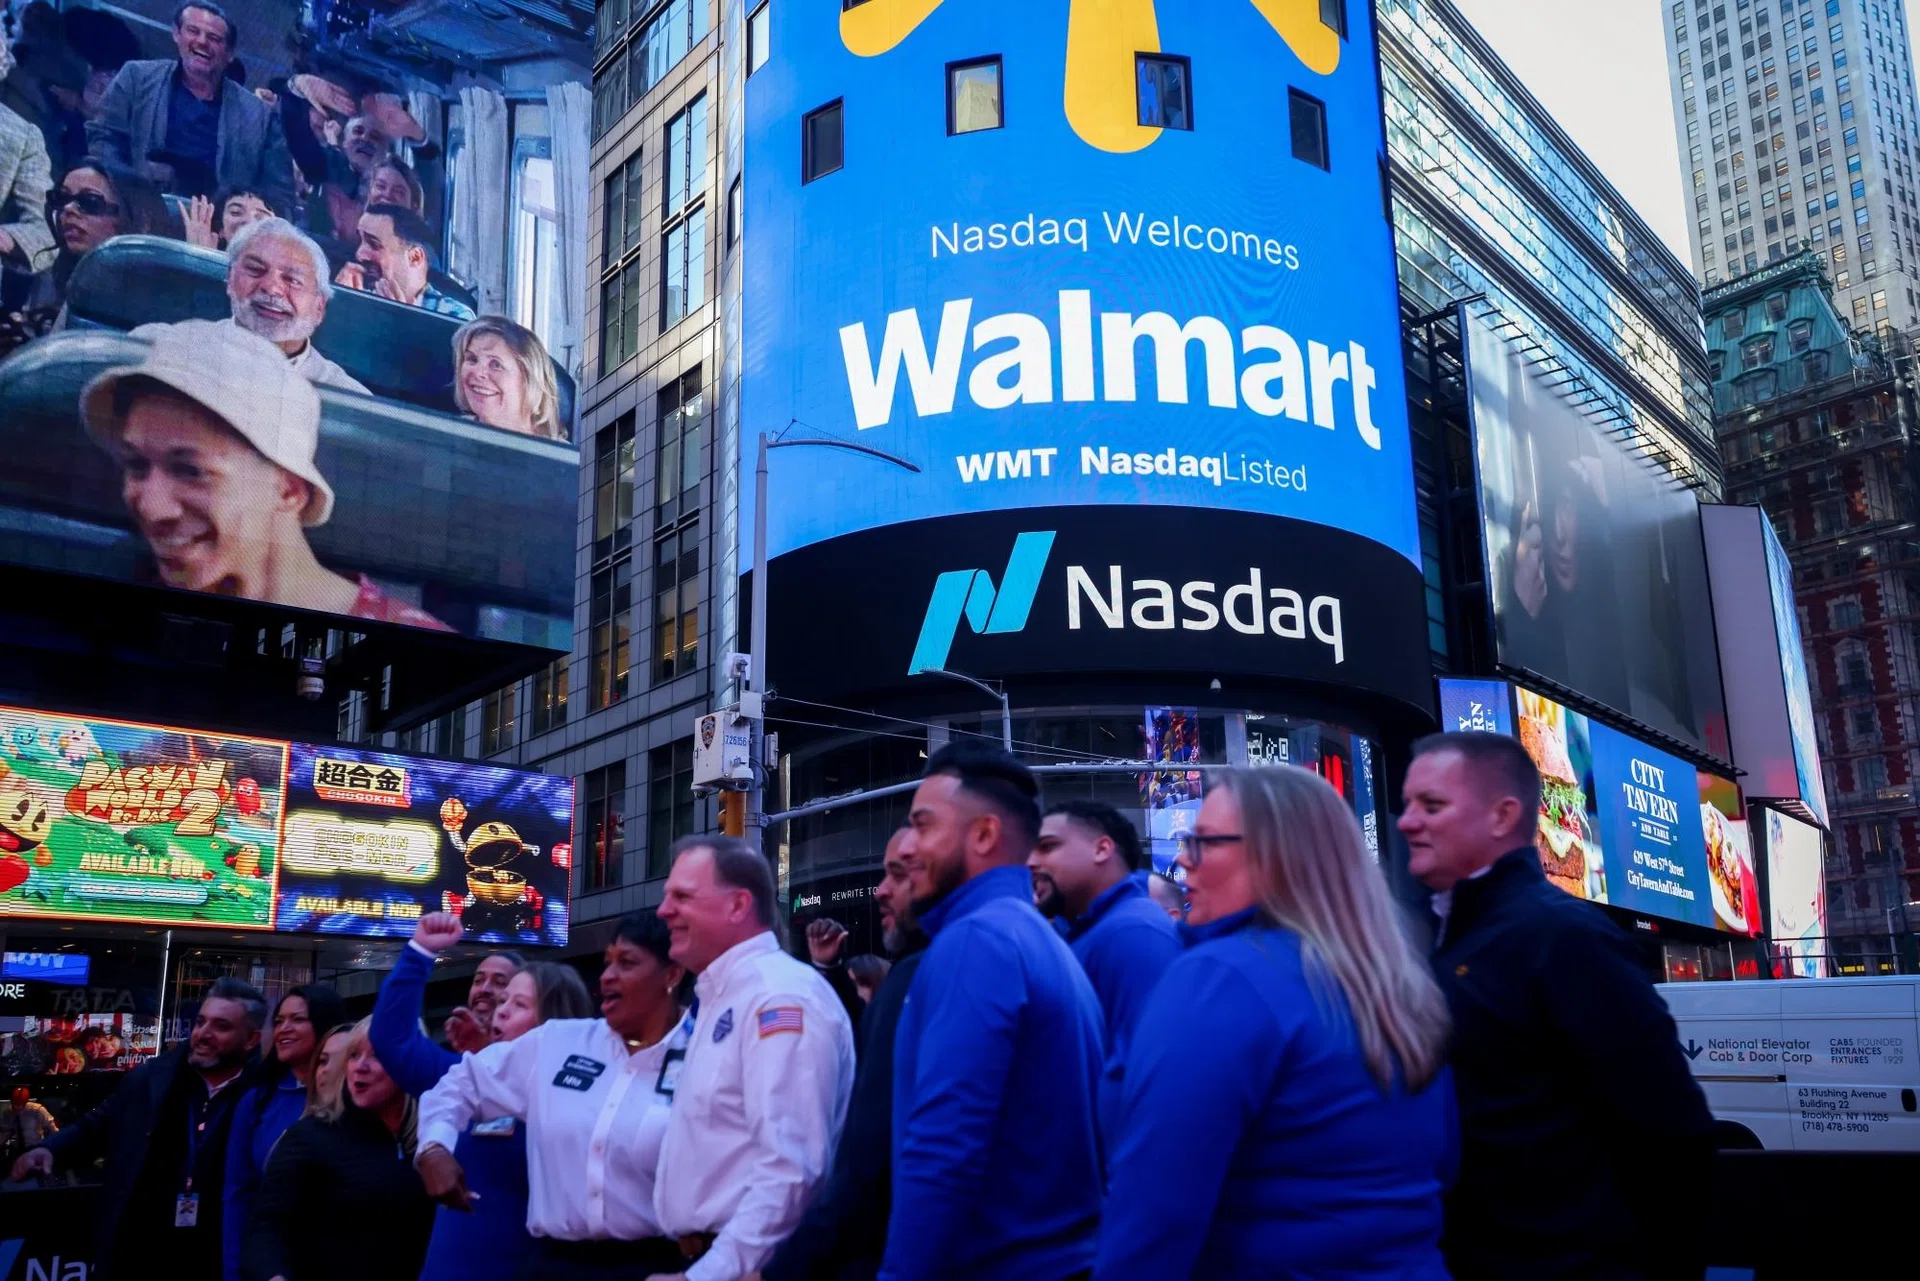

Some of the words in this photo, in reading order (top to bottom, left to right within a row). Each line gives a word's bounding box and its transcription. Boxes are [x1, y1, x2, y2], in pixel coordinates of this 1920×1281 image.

[931, 213, 1087, 258] Nasdaq
[1103, 211, 1300, 270] Welcomes
[839, 289, 1381, 450] Walmart
[957, 447, 1057, 484] WMT
[1067, 565, 1344, 664] Nasdaq
[317, 761, 402, 792] 超合金
[1631, 758, 1665, 792] CITY
[327, 791, 397, 804] CHOGOKIN
[1623, 782, 1678, 824] TAVERN
[85, 789, 182, 816] WORLD
[173, 789, 221, 836] 2
[314, 829, 408, 850] CHOGOKIN
[313, 844, 407, 866] Pac-Man
[1633, 850, 1644, 865] 629
[1643, 852, 1658, 870] West
[1668, 860, 1684, 877] Street
[79, 853, 170, 876] AVAILABLE
[170, 859, 206, 878] NOW
[1628, 870, 1695, 901] CityTavernAndTable.com
[295, 897, 384, 918] AVAILABLE
[387, 902, 423, 918] NOW
[800, 894, 821, 907] Nasdaq
[832, 888, 864, 901] REWRITE
[1708, 1039, 1758, 1050] National
[1761, 1039, 1811, 1050] Elevator
[1829, 1038, 1854, 1047] CABS
[1830, 1047, 1882, 1055] ENTRANCES
[1856, 1037, 1903, 1047] FOUNDED
[1893, 1047, 1904, 1055] IN
[1708, 1051, 1734, 1062] Cab
[1738, 1051, 1746, 1062] &
[1749, 1051, 1779, 1062] Door
[1781, 1051, 1813, 1065] Corp
[1831, 1056, 1869, 1064] FIXTURES
[1883, 1055, 1904, 1065] 1929
[1798, 1088, 1809, 1097] 63
[1811, 1088, 1848, 1100] Flushing
[1851, 1090, 1887, 1099] Avenue
[1800, 1100, 1836, 1110] Building
[1838, 1101, 1850, 1109] 22
[1801, 1111, 1844, 1121] Brooklyn,
[1846, 1112, 1859, 1120] NY
[1863, 1113, 1889, 1122] 11205
[1802, 1121, 1824, 1133] (718)
[1826, 1122, 1869, 1132] 478-5900
